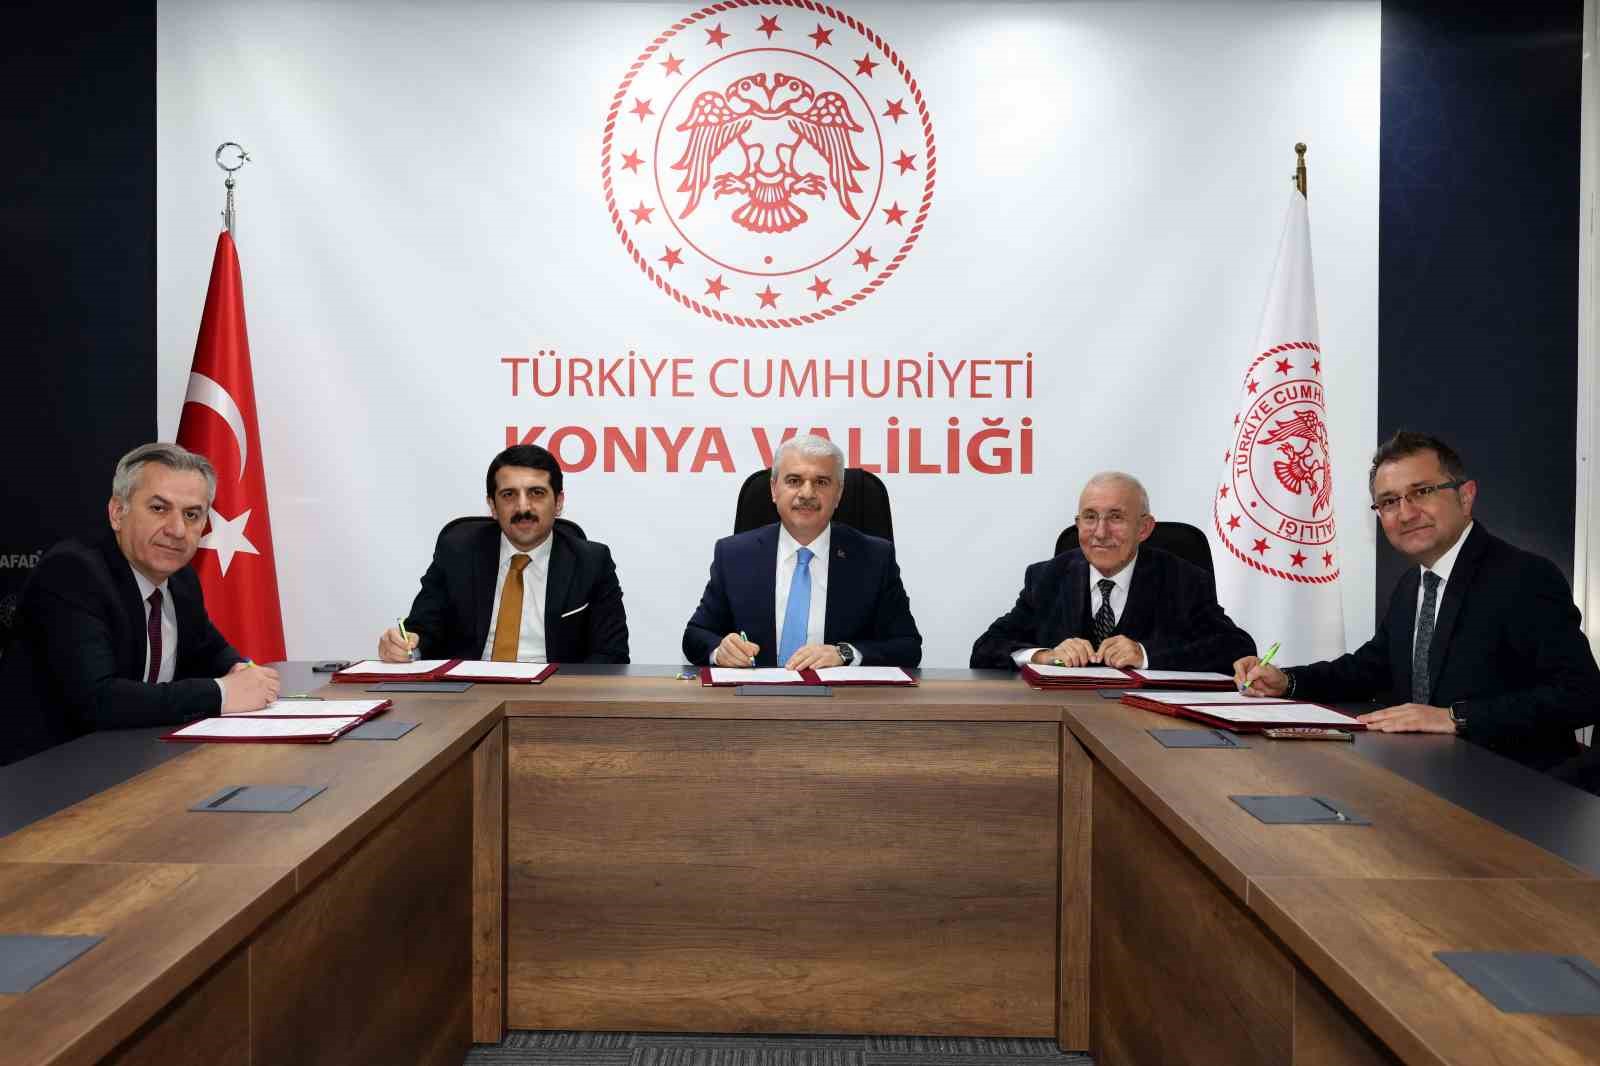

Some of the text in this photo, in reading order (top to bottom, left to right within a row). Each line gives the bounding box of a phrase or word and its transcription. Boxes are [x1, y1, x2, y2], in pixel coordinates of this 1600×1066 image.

[501, 350, 1033, 399] TÜRKİYE CUMHURİYETİ
[751, 416, 1034, 474] VLİLİĞİ
[0, 554, 40, 568] AFAD
